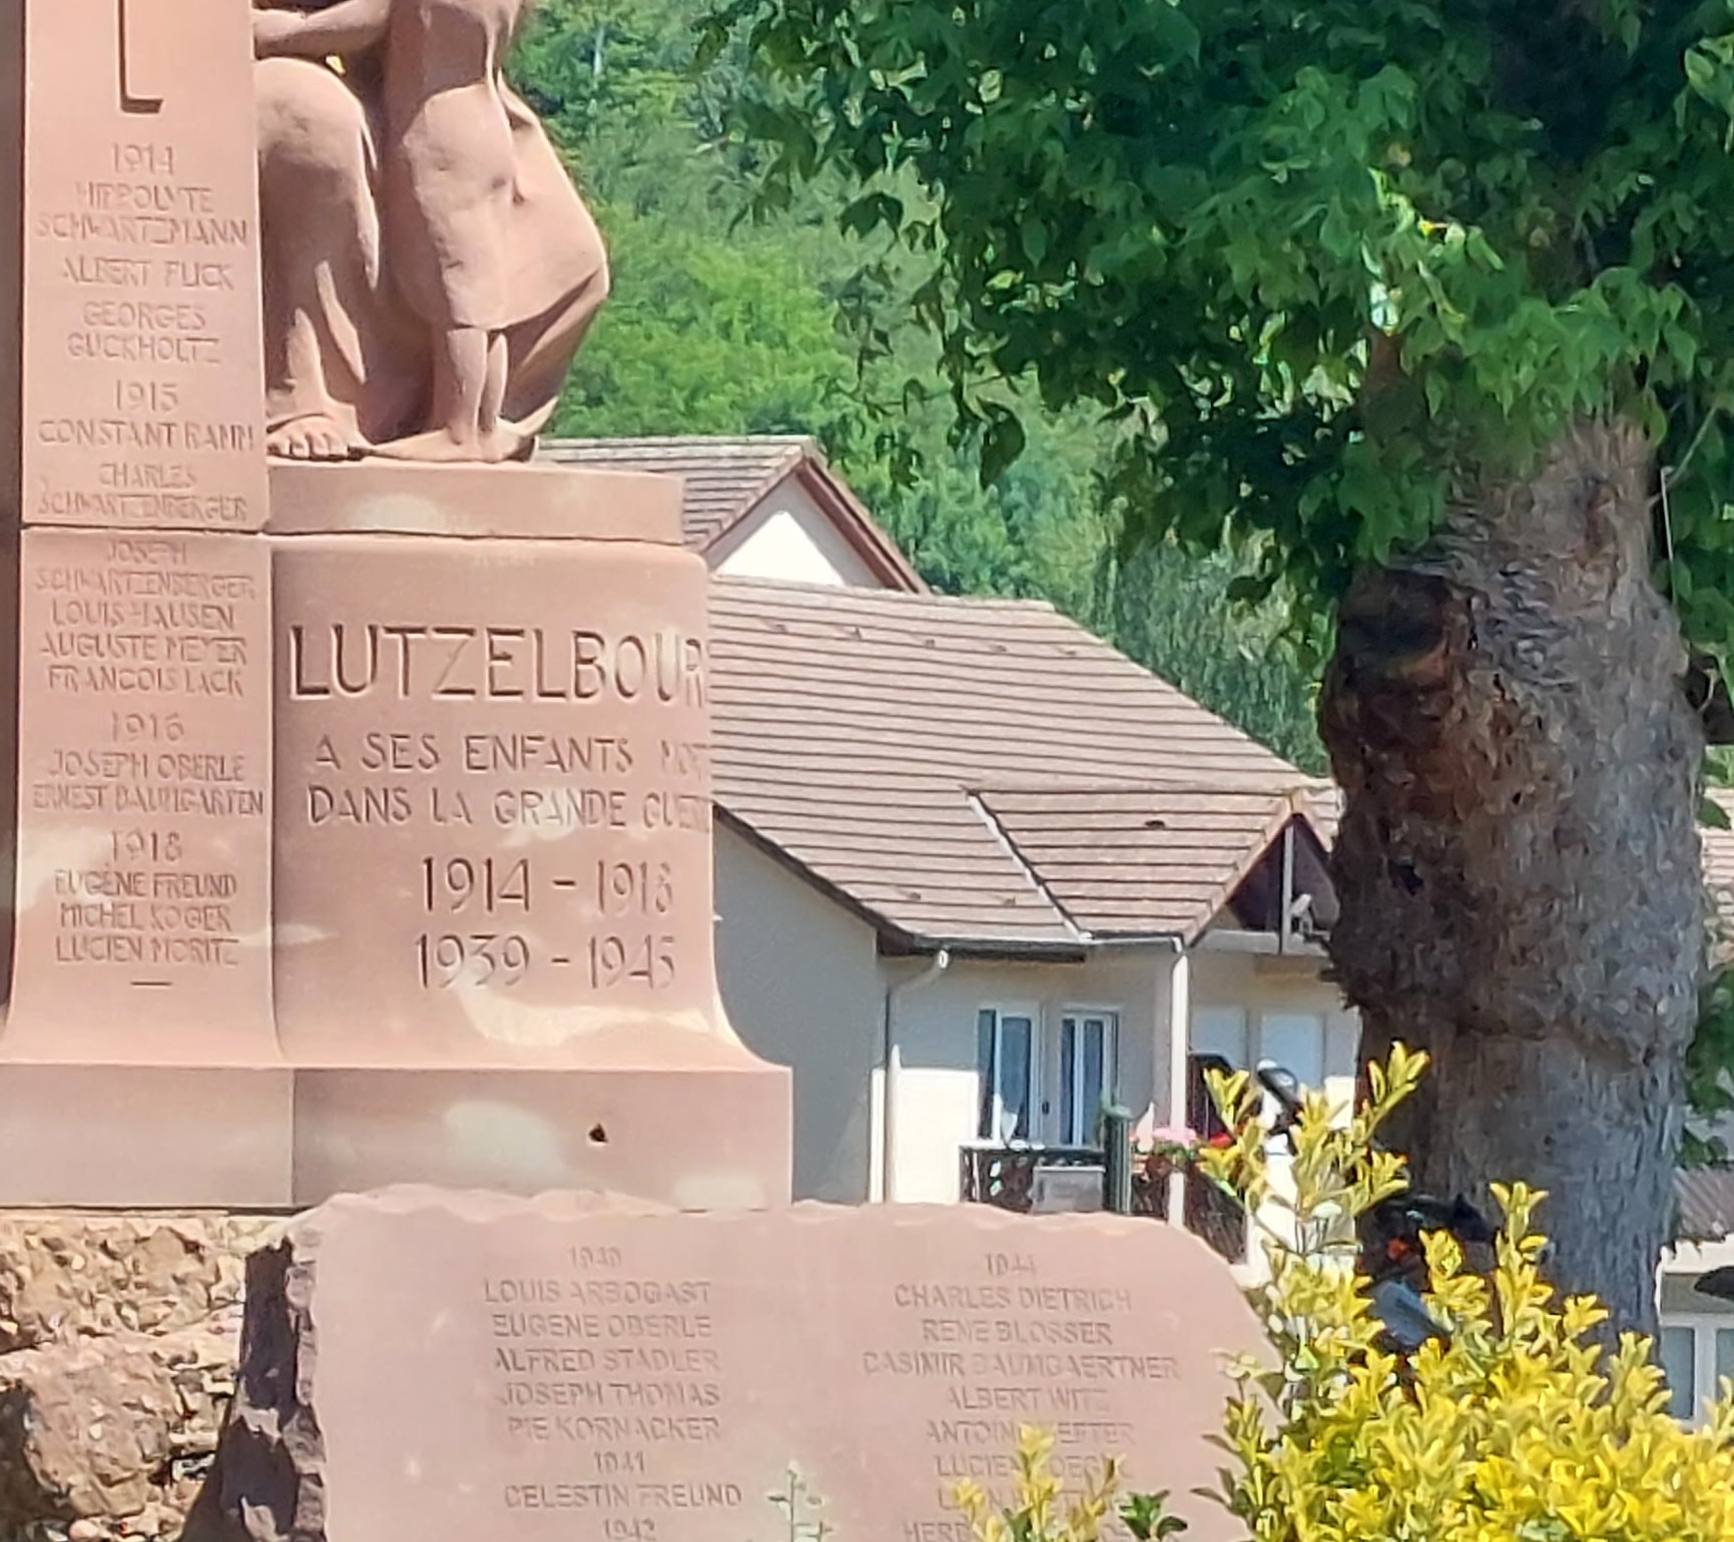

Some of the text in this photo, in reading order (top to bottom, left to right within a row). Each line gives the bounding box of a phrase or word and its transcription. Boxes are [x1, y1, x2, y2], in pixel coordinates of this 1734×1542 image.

[75, 181, 214, 213] HIPPOLYTE
[62, 255, 152, 287] ALBERT
[83, 300, 207, 330] GEORGES
[114, 378, 180, 412] 1915
[38, 418, 178, 449] CONSTANT
[98, 461, 198, 489] CHARLES
[108, 538, 187, 565] JOSEPH
[51, 598, 124, 628] LOUIS
[40, 631, 249, 666] AUGUSTE MEYER
[290, 622, 705, 709] LUTZELBOUR
[184, 665, 245, 698] LACK
[111, 709, 186, 743] 1916
[48, 747, 246, 781] JOSEPH OBERLE
[314, 734, 342, 770] A
[362, 733, 441, 771] SES
[464, 733, 635, 775] ENFANTS
[32, 782, 110, 810] ERNEST
[307, 784, 413, 825] DANS
[431, 786, 475, 825] LA
[493, 790, 627, 828] GRANDE
[112, 826, 184, 862] 1918
[152, 871, 239, 899] FREUND
[421, 855, 532, 914] 1914
[597, 858, 674, 915] 1918
[59, 901, 145, 930] MICHEL
[54, 934, 144, 963] LUCIEN
[416, 932, 532, 990] 1939
[587, 934, 677, 990] 1945
[484, 1276, 713, 1306] LOUIS ARBOGAST
[892, 1281, 1134, 1313] CHARLES DIETRICH
[492, 1311, 715, 1339] EUGENE OBERLE
[921, 1317, 991, 1343] RENE
[493, 1345, 723, 1374] ALFRED STADLER
[860, 1350, 967, 1379] CASIMIR
[499, 1380, 723, 1408] JOSEPH THOMAS
[946, 1385, 1042, 1413] ALBERT
[555, 1415, 722, 1443] KORNACKER
[925, 1419, 1023, 1446] ANTOIN
[503, 1481, 744, 1510] CELESTIN FREUND
